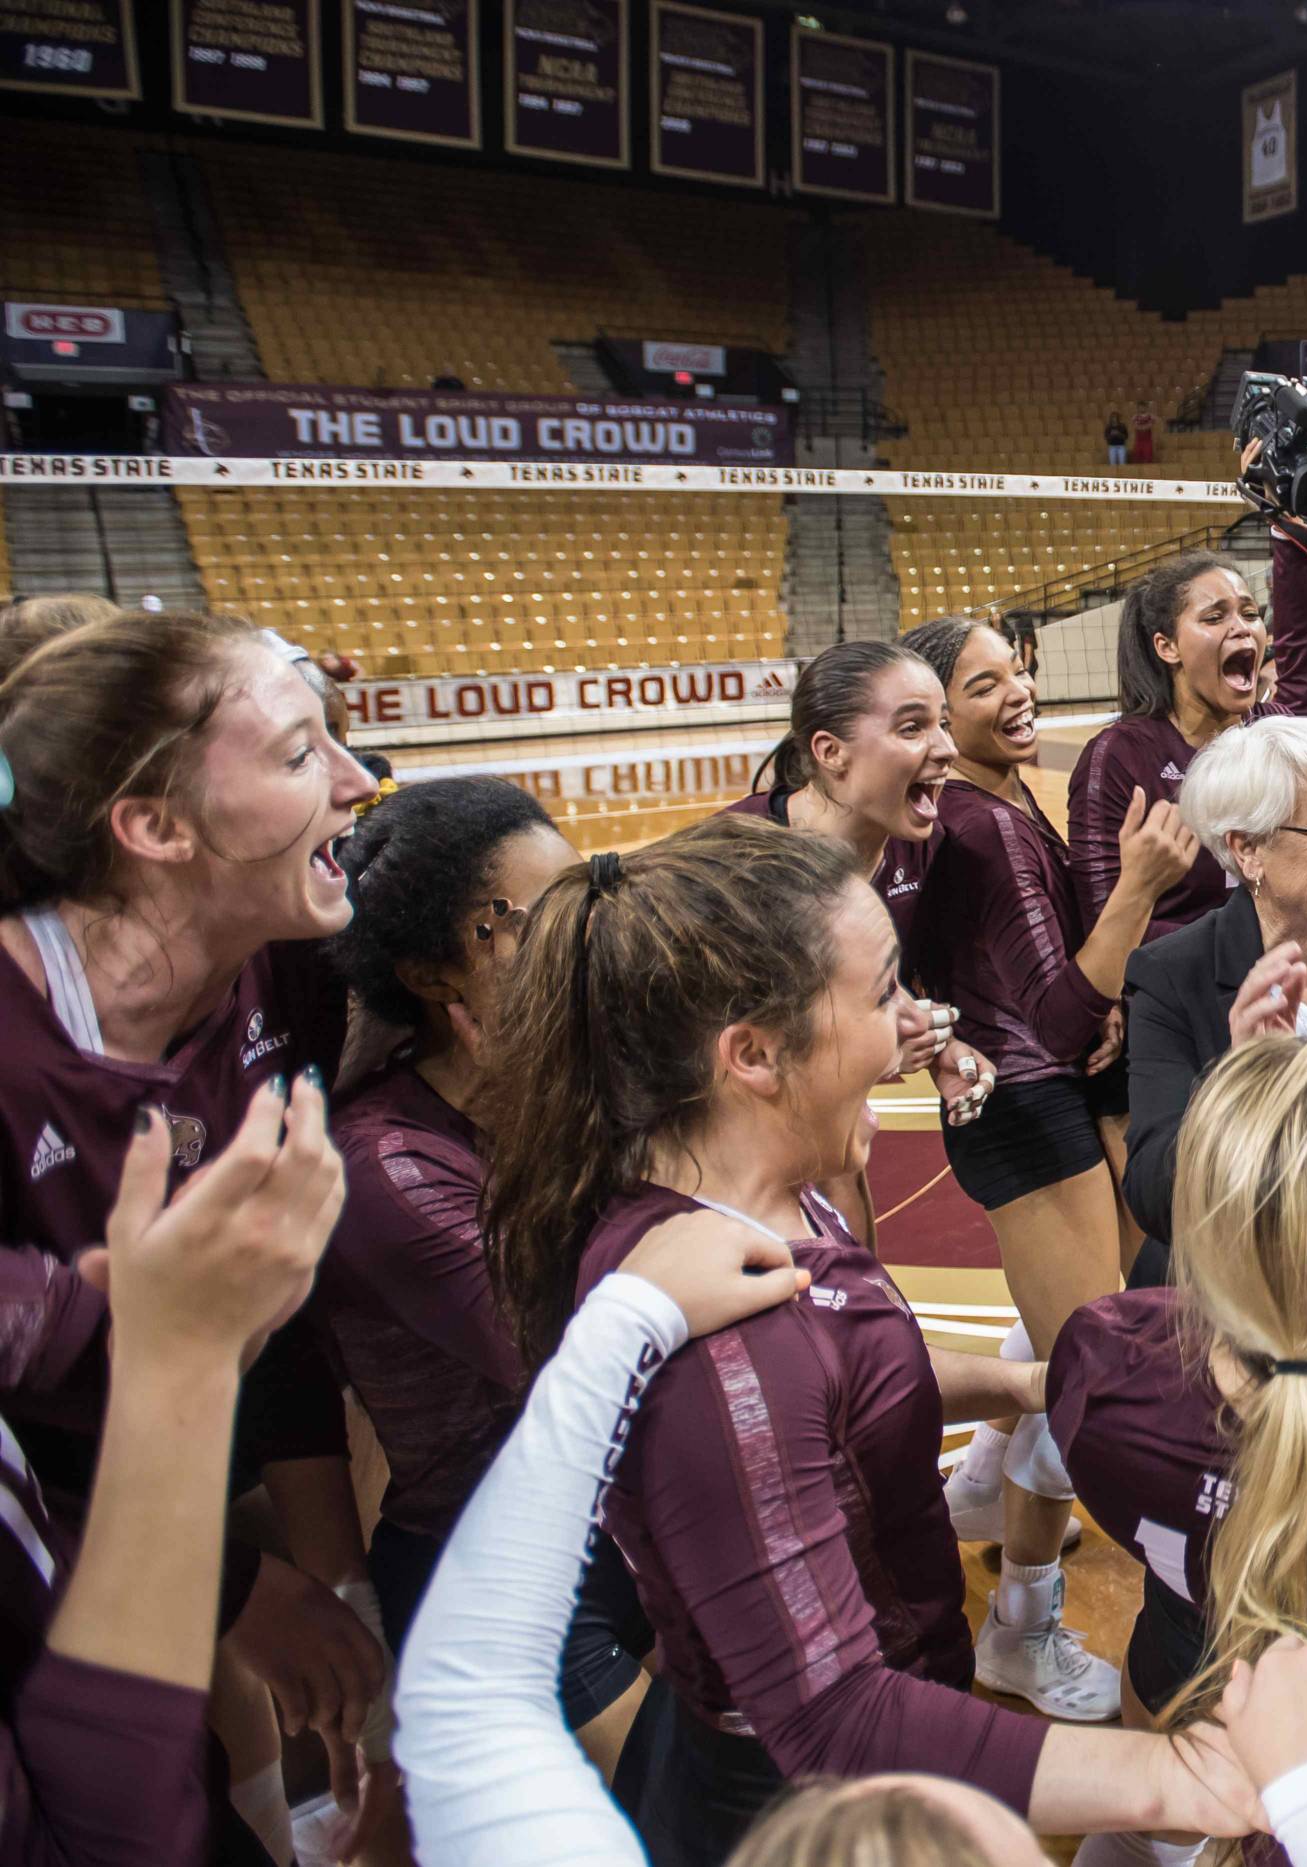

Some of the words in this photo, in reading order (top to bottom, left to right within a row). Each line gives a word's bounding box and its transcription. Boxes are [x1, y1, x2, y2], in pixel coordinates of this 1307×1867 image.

[287, 407, 384, 447] THE
[397, 412, 523, 451] LOUD
[536, 417, 697, 456] CROWD
[93, 458, 172, 478] STATE
[271, 461, 349, 479] TEXAS
[355, 463, 424, 480] STATE
[510, 465, 577, 482] TEXAS
[584, 467, 642, 483] STATE
[719, 469, 778, 484] TEXAS
[784, 470, 836, 486] STATE
[902, 474, 954, 489] TEXAS
[959, 476, 1004, 490] STATE
[1063, 479, 1109, 493] TEXAS
[1114, 481, 1154, 494] STATE
[1206, 484, 1240, 497] TEXA
[343, 688, 403, 723] HE
[427, 681, 556, 719] LOUD
[579, 671, 745, 709] CROWD
[31, 1144, 77, 1182] adidas
